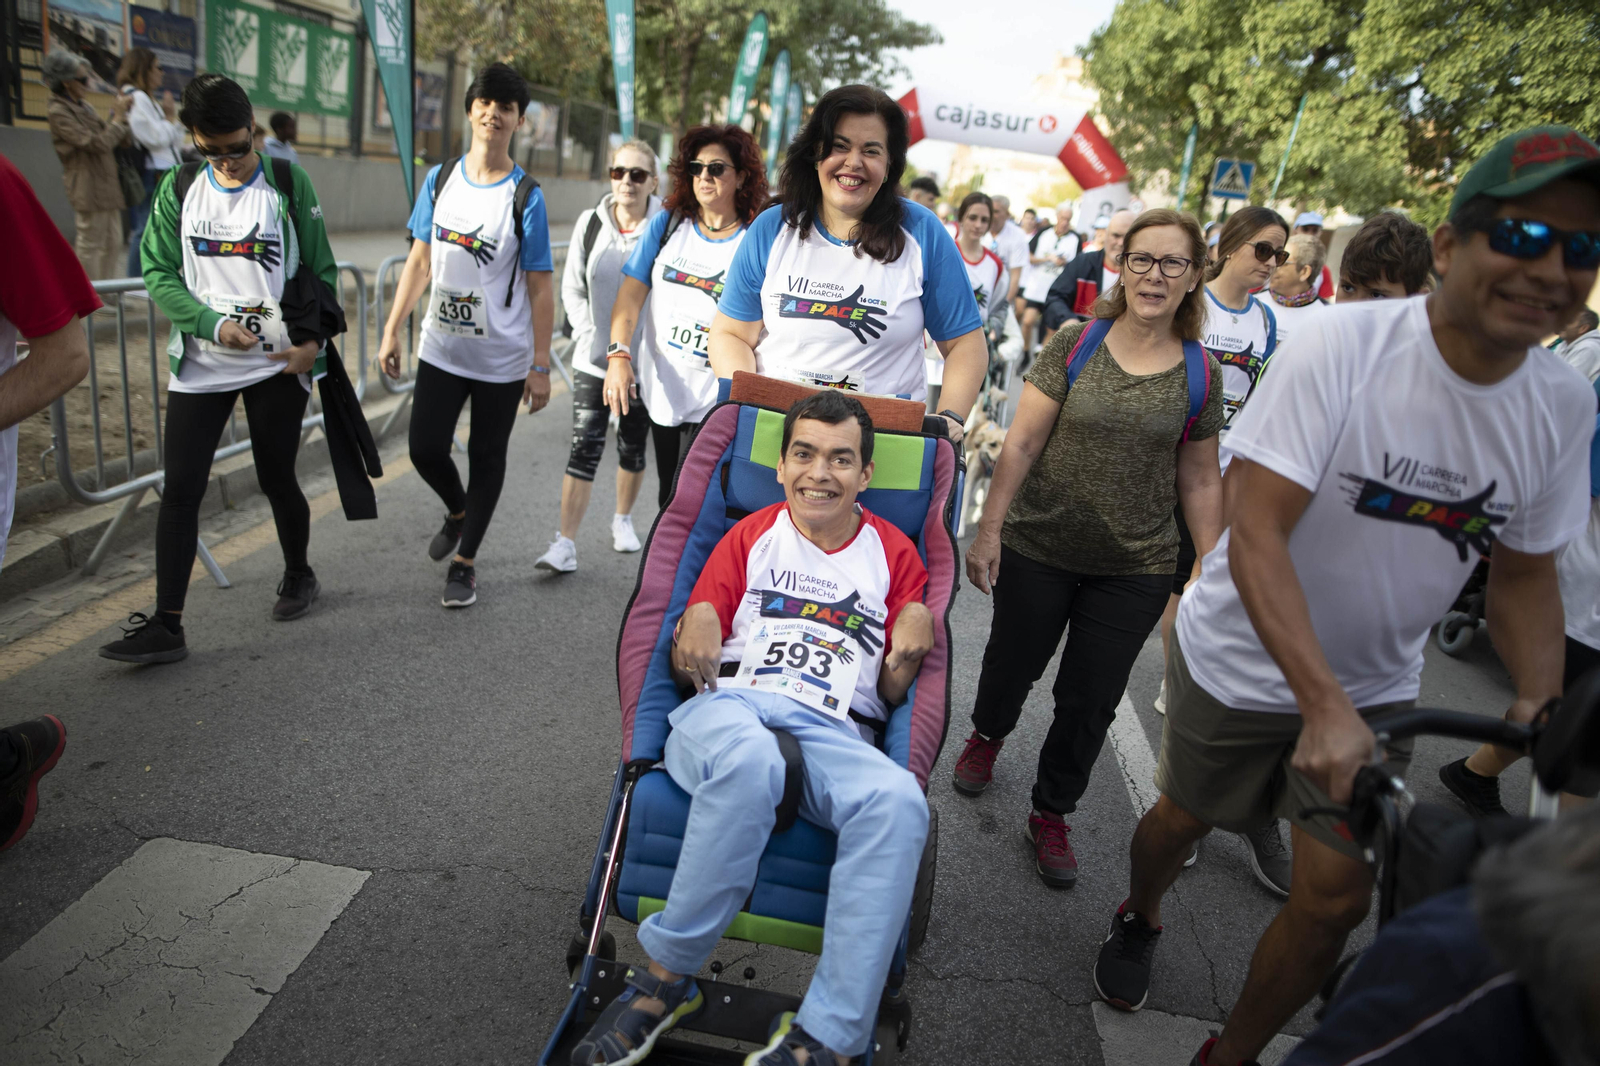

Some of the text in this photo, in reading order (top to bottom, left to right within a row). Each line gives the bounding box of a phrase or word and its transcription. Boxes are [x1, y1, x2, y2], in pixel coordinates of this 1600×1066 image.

[935, 103, 1034, 133] cajasur
[191, 220, 211, 235] VII
[197, 240, 266, 254] ASPACE
[665, 269, 724, 293] ASPACE
[788, 275, 845, 293] VII CARRERA
[808, 289, 843, 299] MARCHA
[439, 301, 473, 321] 430
[783, 300, 867, 320] ASPACE
[1220, 342, 1242, 350] MARCHA
[1221, 336, 1243, 344] CARRERA
[1209, 350, 1258, 367] SPACE
[1384, 452, 1467, 487] VII CARRERA
[1416, 479, 1462, 498] MARCHA
[1366, 493, 1490, 533] ASPACE
[770, 569, 838, 591] VII CARRERA
[799, 585, 837, 601] MARCHA
[766, 597, 864, 630] ASPACE
[804, 625, 827, 638] MARCHA
[763, 641, 833, 678] 593
